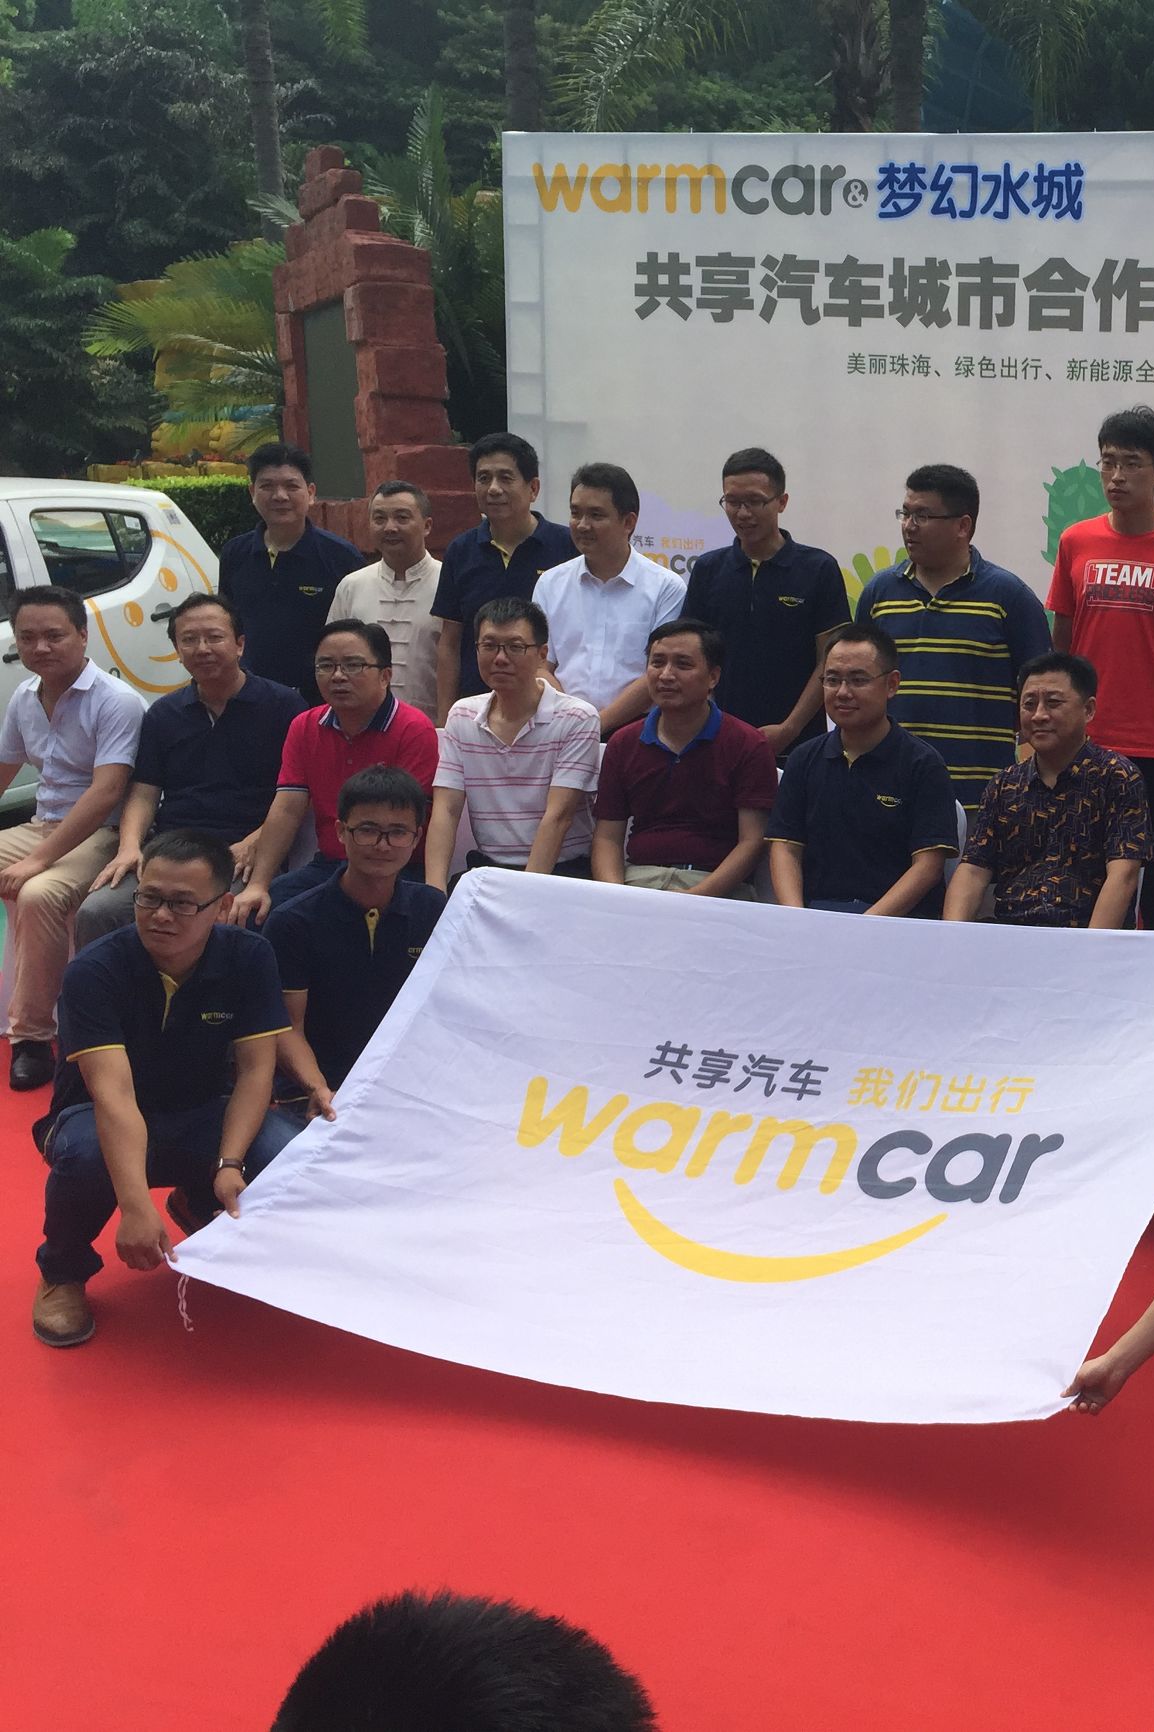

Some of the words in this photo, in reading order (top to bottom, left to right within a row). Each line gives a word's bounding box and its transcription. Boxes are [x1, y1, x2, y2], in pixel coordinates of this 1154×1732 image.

[532, 162, 846, 217] warmcar
[877, 162, 1085, 221] 梦幻水城
[1095, 563, 1153, 588] TEAM
[644, 1040, 830, 1100] 共享汽车
[847, 1066, 1036, 1115] 我们出行
[515, 1075, 1065, 1205] warmcar
